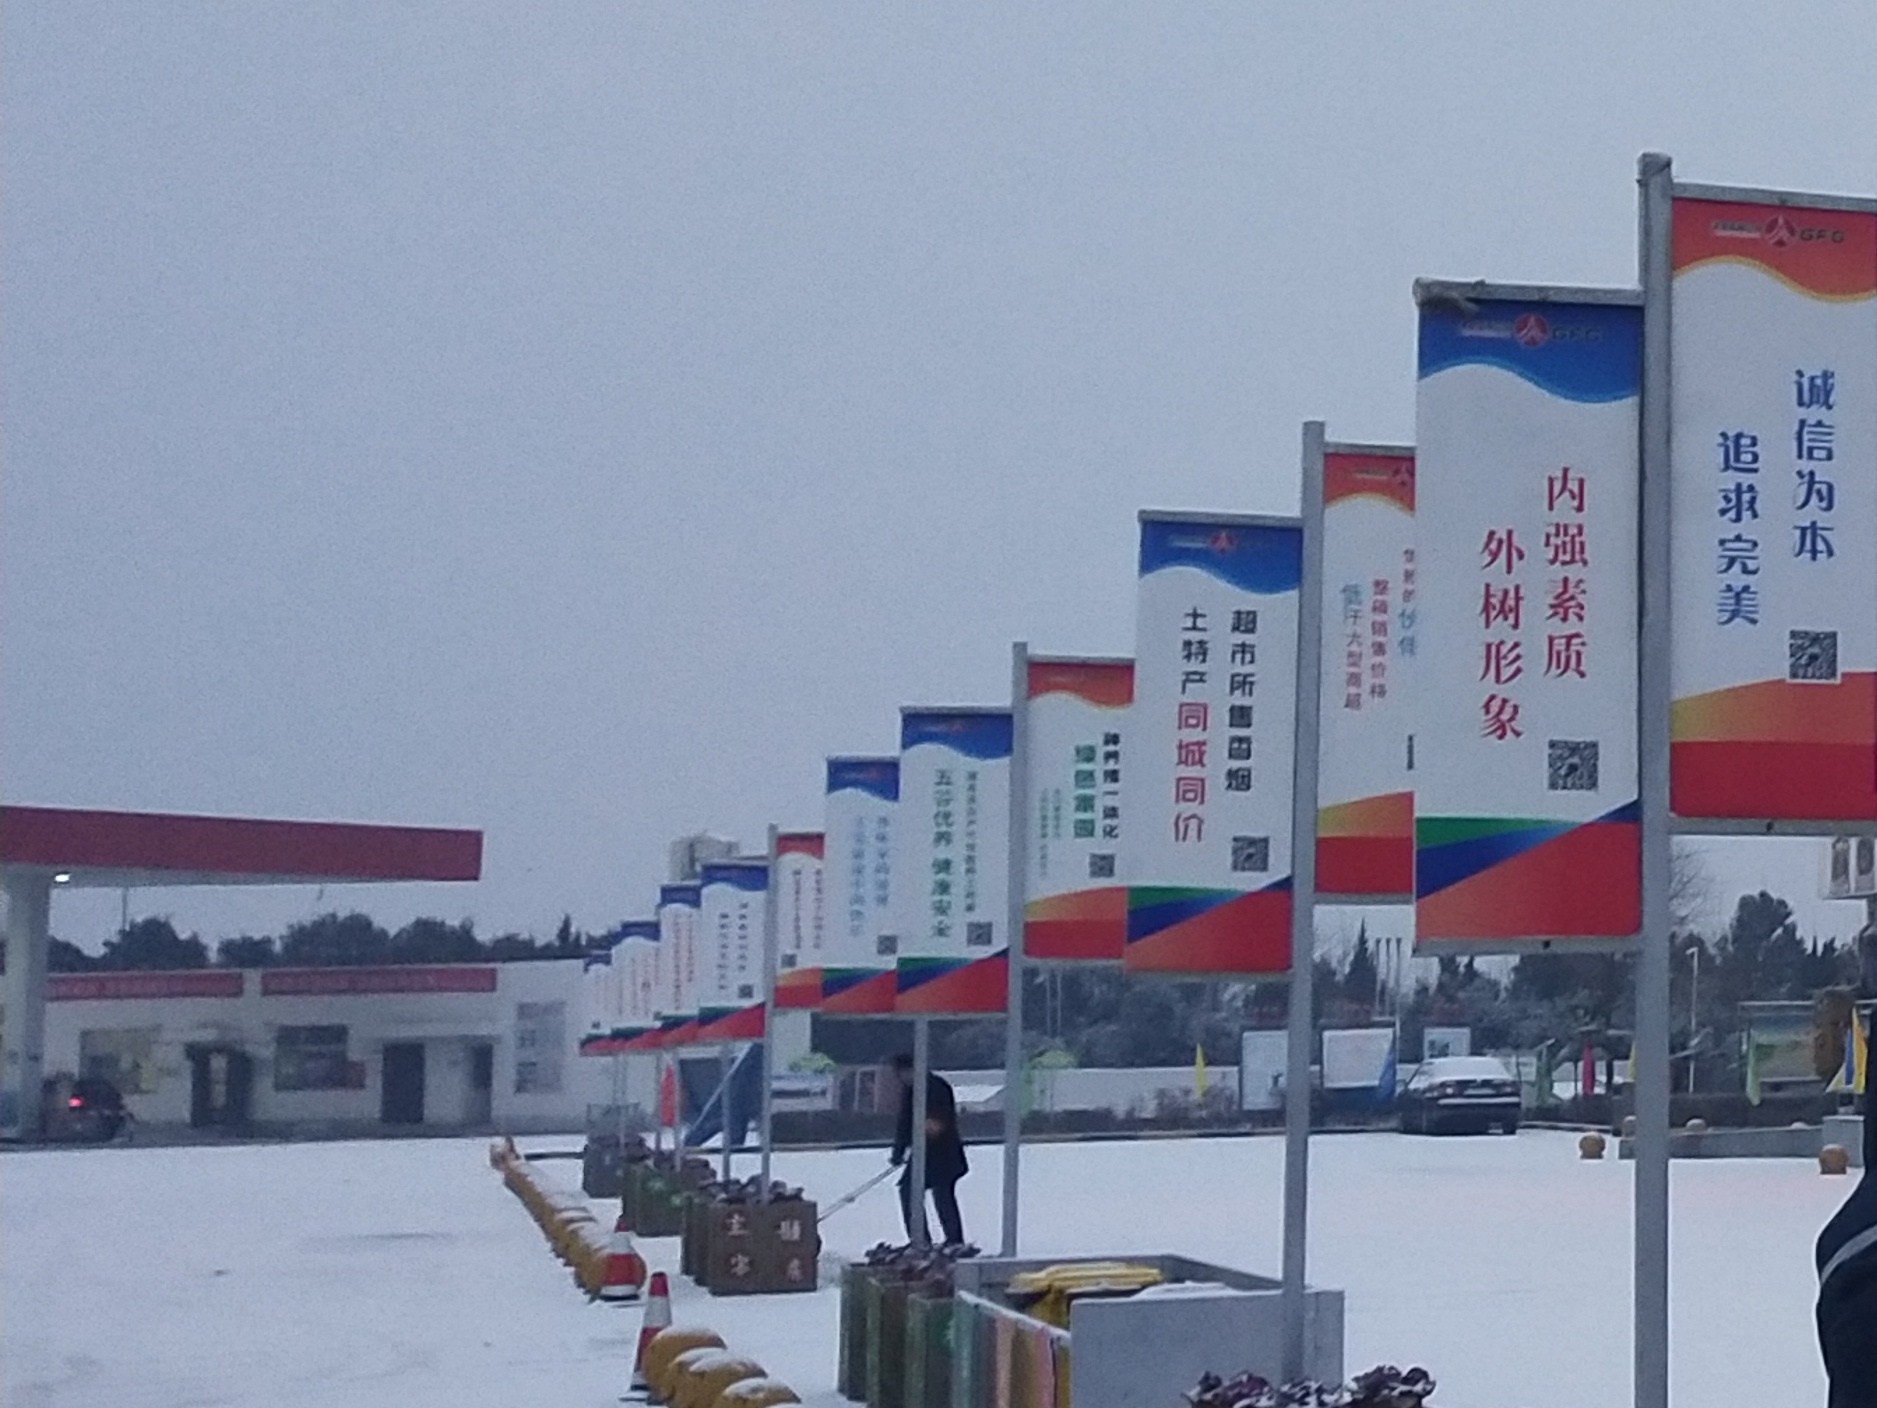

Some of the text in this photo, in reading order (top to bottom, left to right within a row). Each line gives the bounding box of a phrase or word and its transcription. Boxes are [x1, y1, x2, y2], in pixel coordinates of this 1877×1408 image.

[1716, 431, 1761, 626] 追求完美
[1793, 368, 1837, 563] 诚信为本
[1478, 528, 1525, 742] 外树形象
[1543, 466, 1590, 681] 内强素质
[1173, 606, 1209, 844] 土特产同城同价
[1224, 609, 1259, 793] 超市所售香烟
